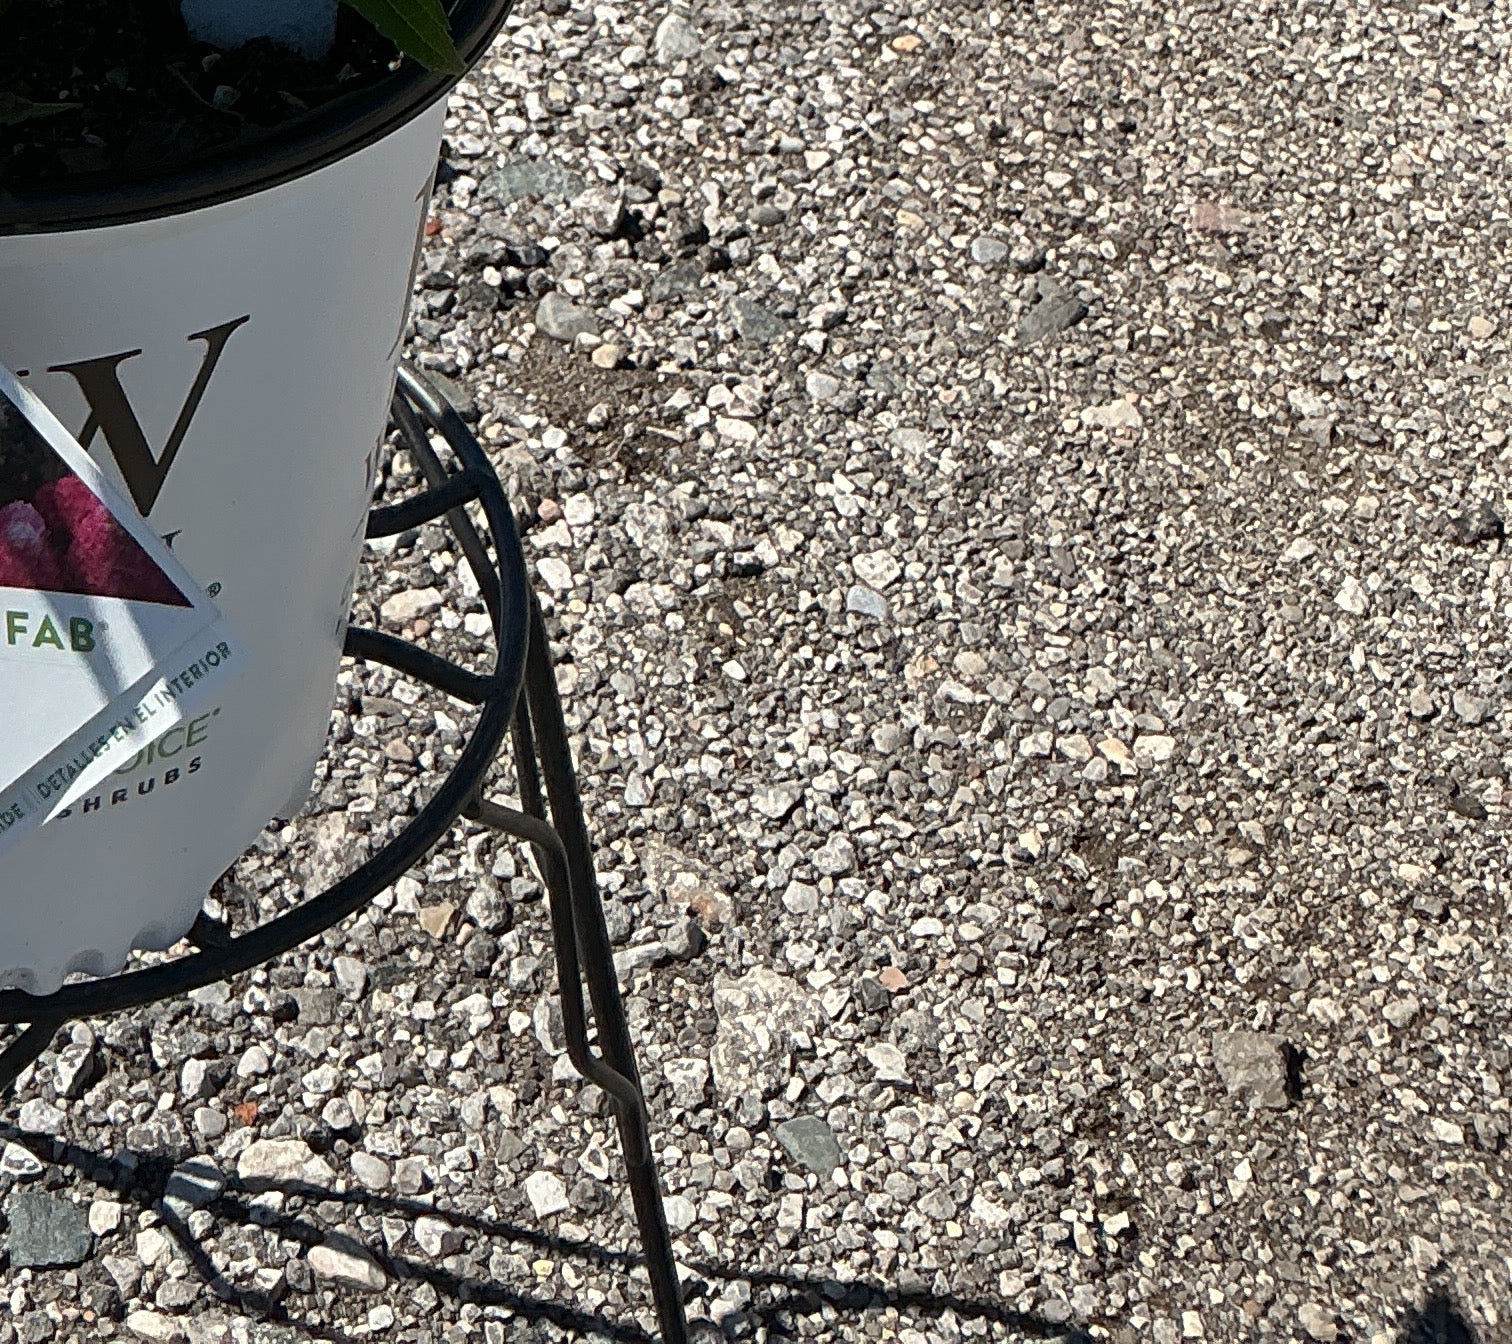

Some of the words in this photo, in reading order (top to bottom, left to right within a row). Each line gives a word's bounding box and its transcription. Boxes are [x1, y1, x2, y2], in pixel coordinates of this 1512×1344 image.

[6, 610, 97, 653] FAB
[37, 733, 111, 800] DETALLES
[109, 716, 137, 743] EN
[134, 701, 157, 724] EL
[154, 641, 232, 708] INTERIOR
